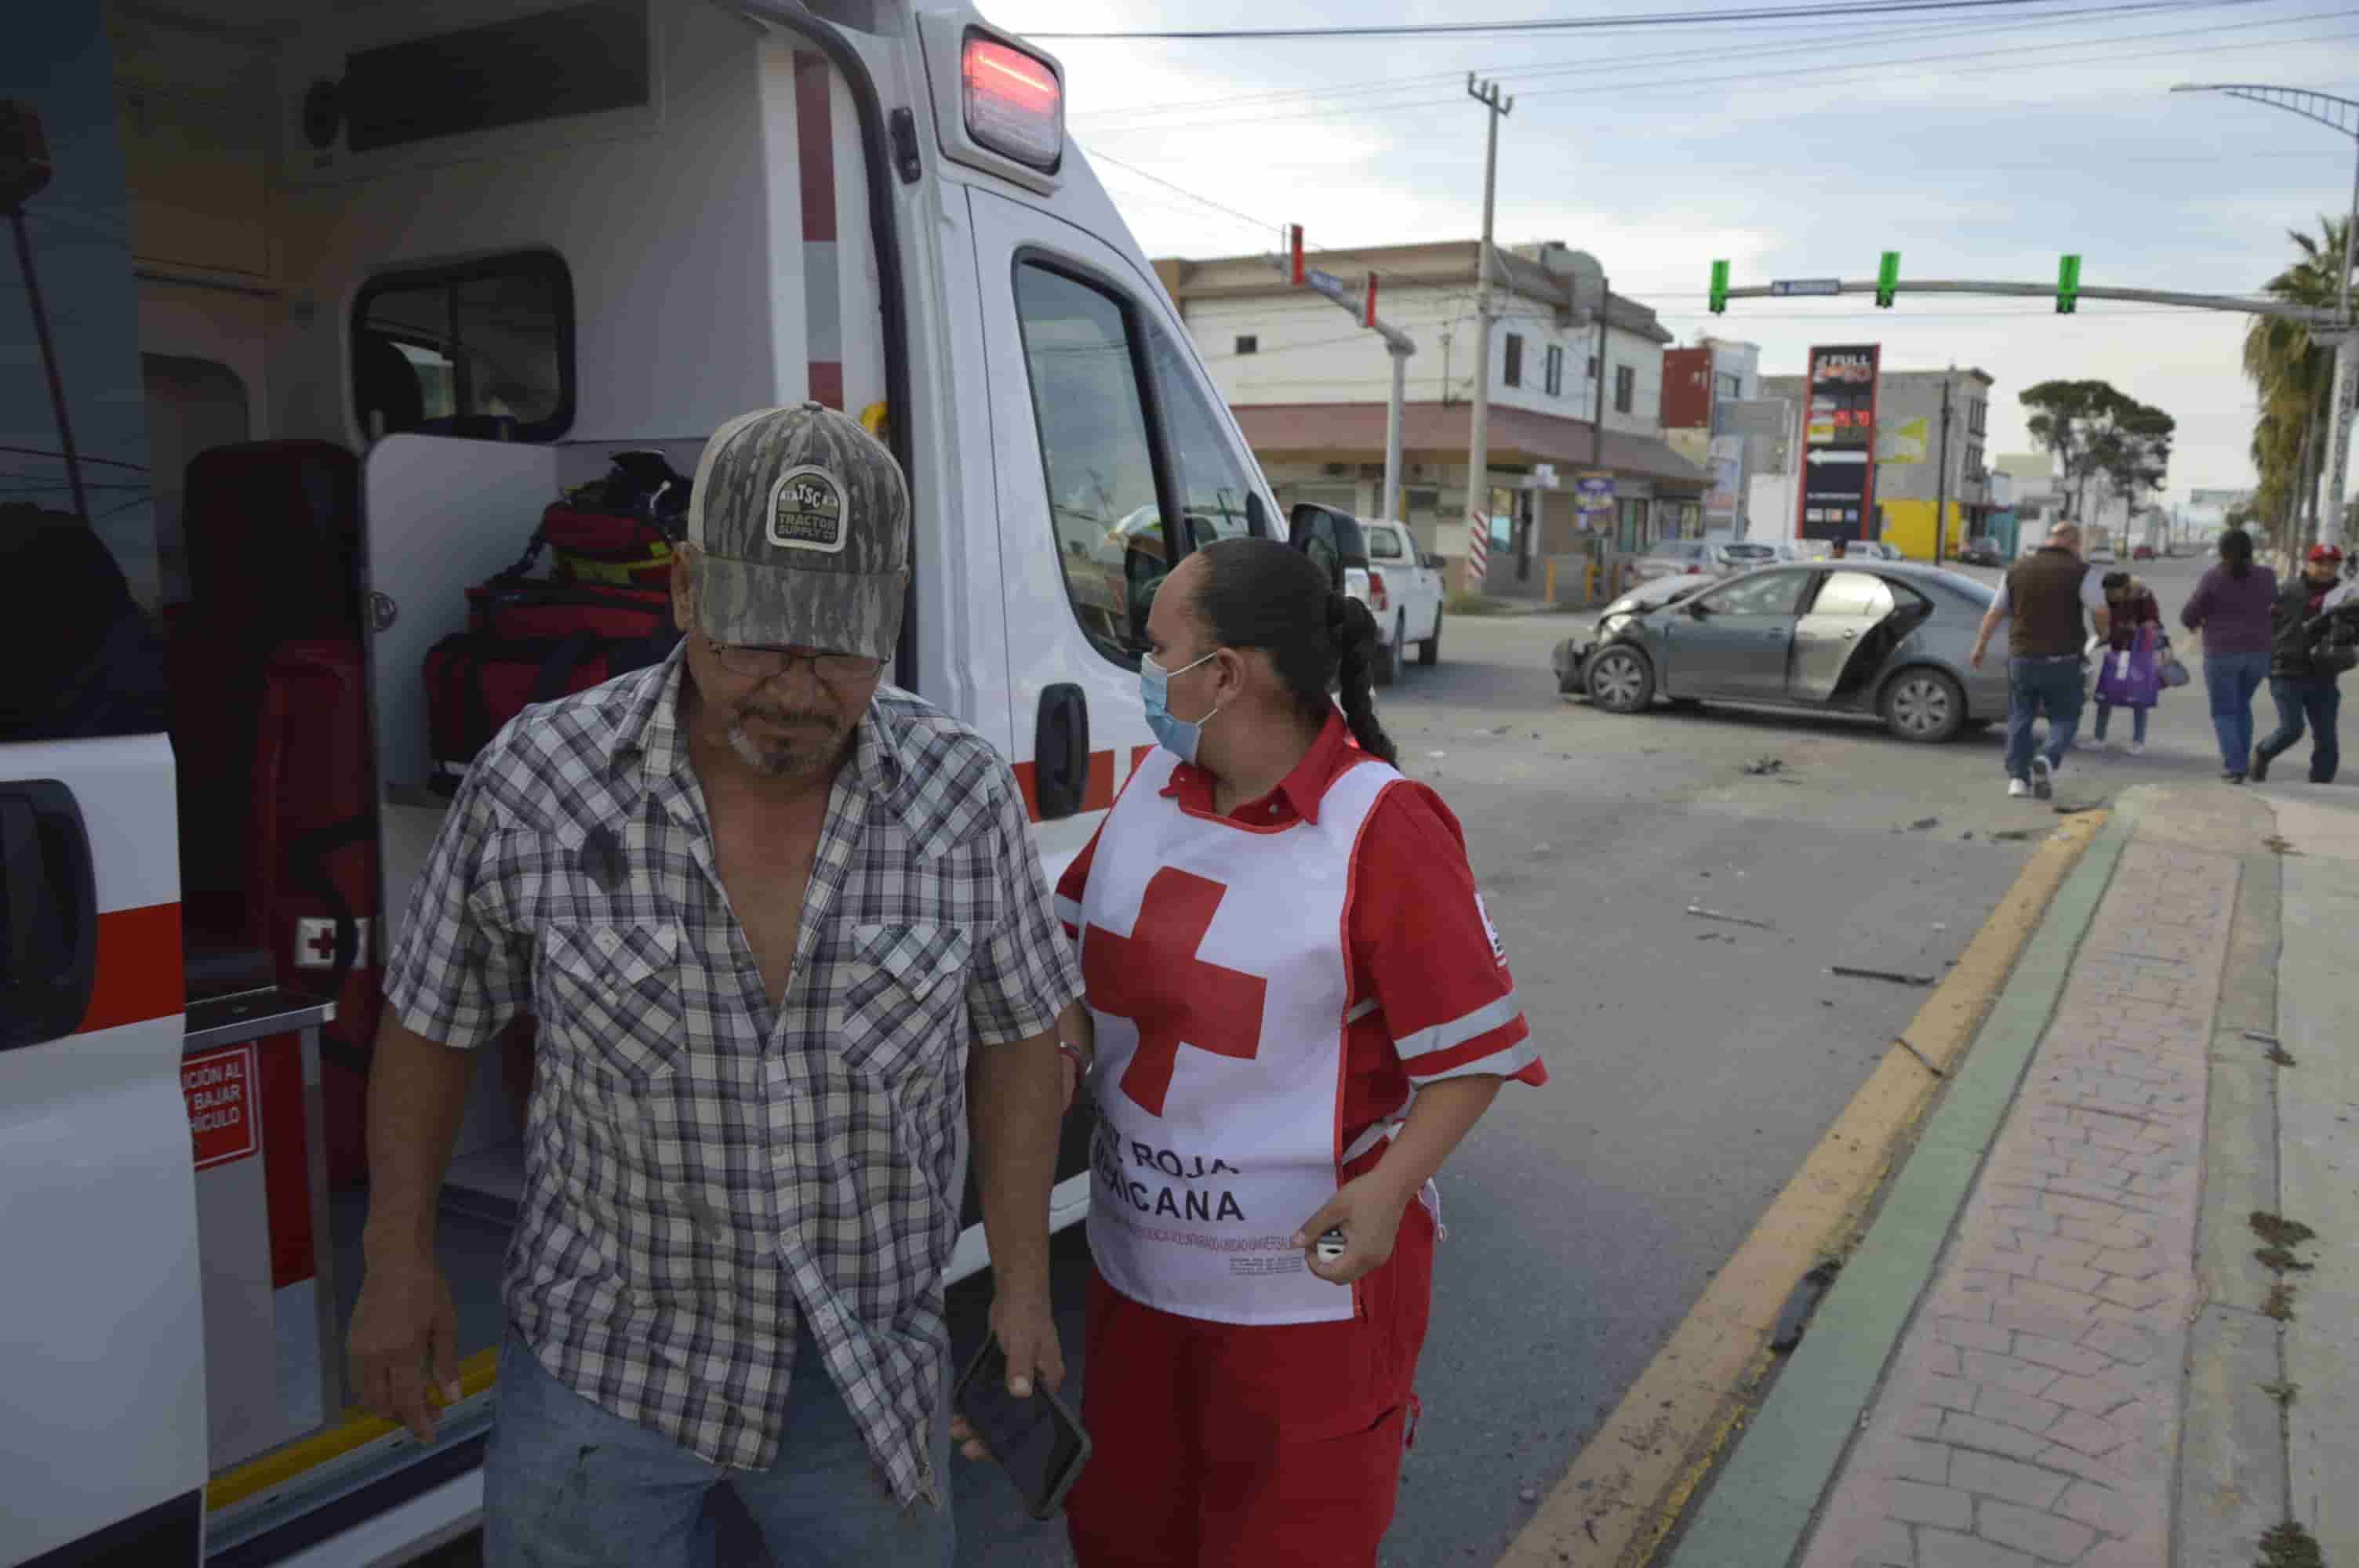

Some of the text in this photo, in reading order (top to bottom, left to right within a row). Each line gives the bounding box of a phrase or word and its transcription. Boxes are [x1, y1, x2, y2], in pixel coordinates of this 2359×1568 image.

[798, 484, 823, 510] TSC
[779, 514, 836, 531] TRACTOR
[225, 1062, 245, 1081] AL
[194, 1084, 240, 1109] BAJAR
